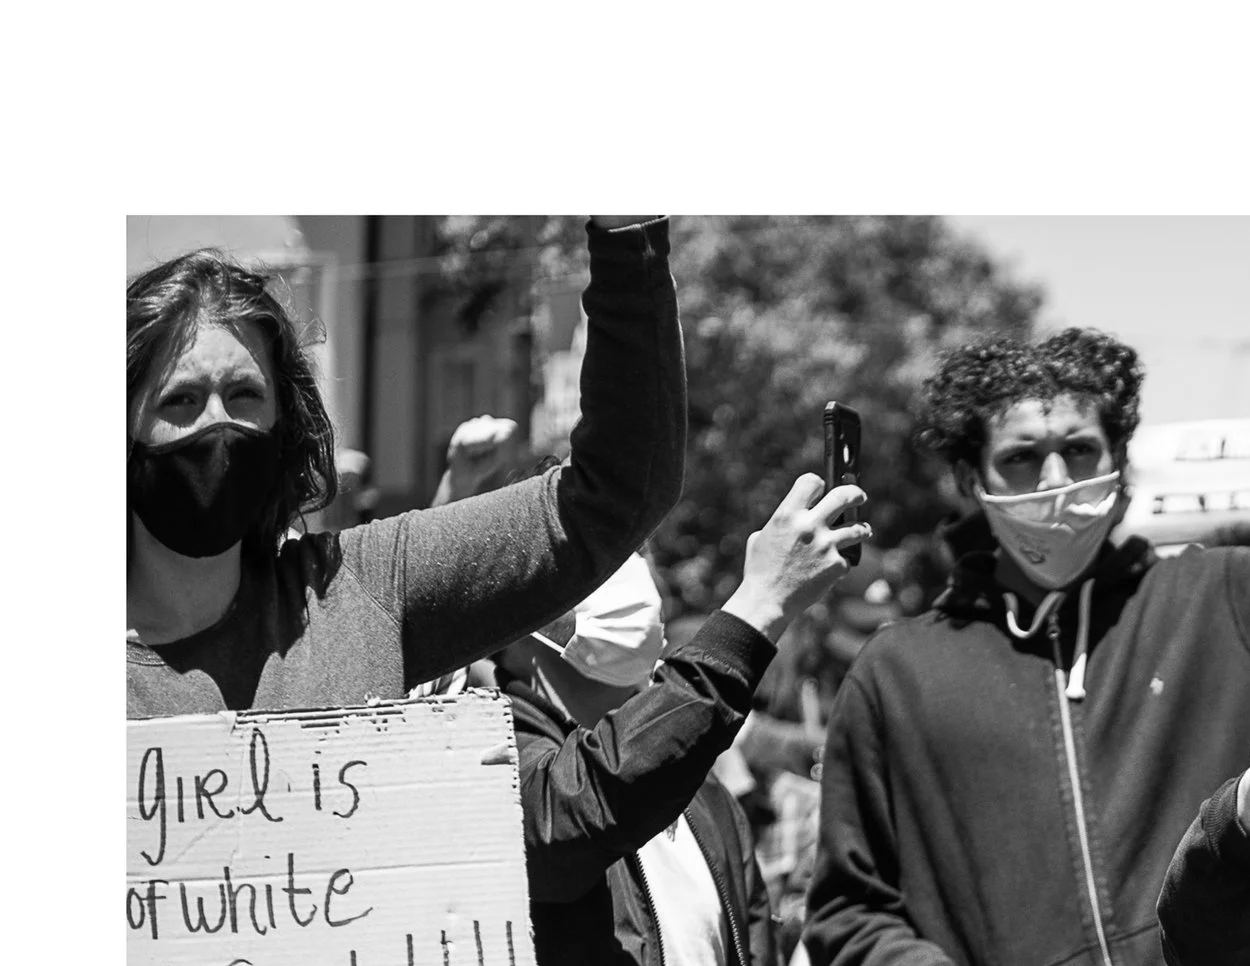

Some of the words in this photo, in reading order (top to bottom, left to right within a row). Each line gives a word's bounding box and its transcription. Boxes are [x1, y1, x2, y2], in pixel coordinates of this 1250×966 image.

[312, 751, 367, 818] is
[126, 879, 169, 940] of
[180, 853, 374, 936] white
